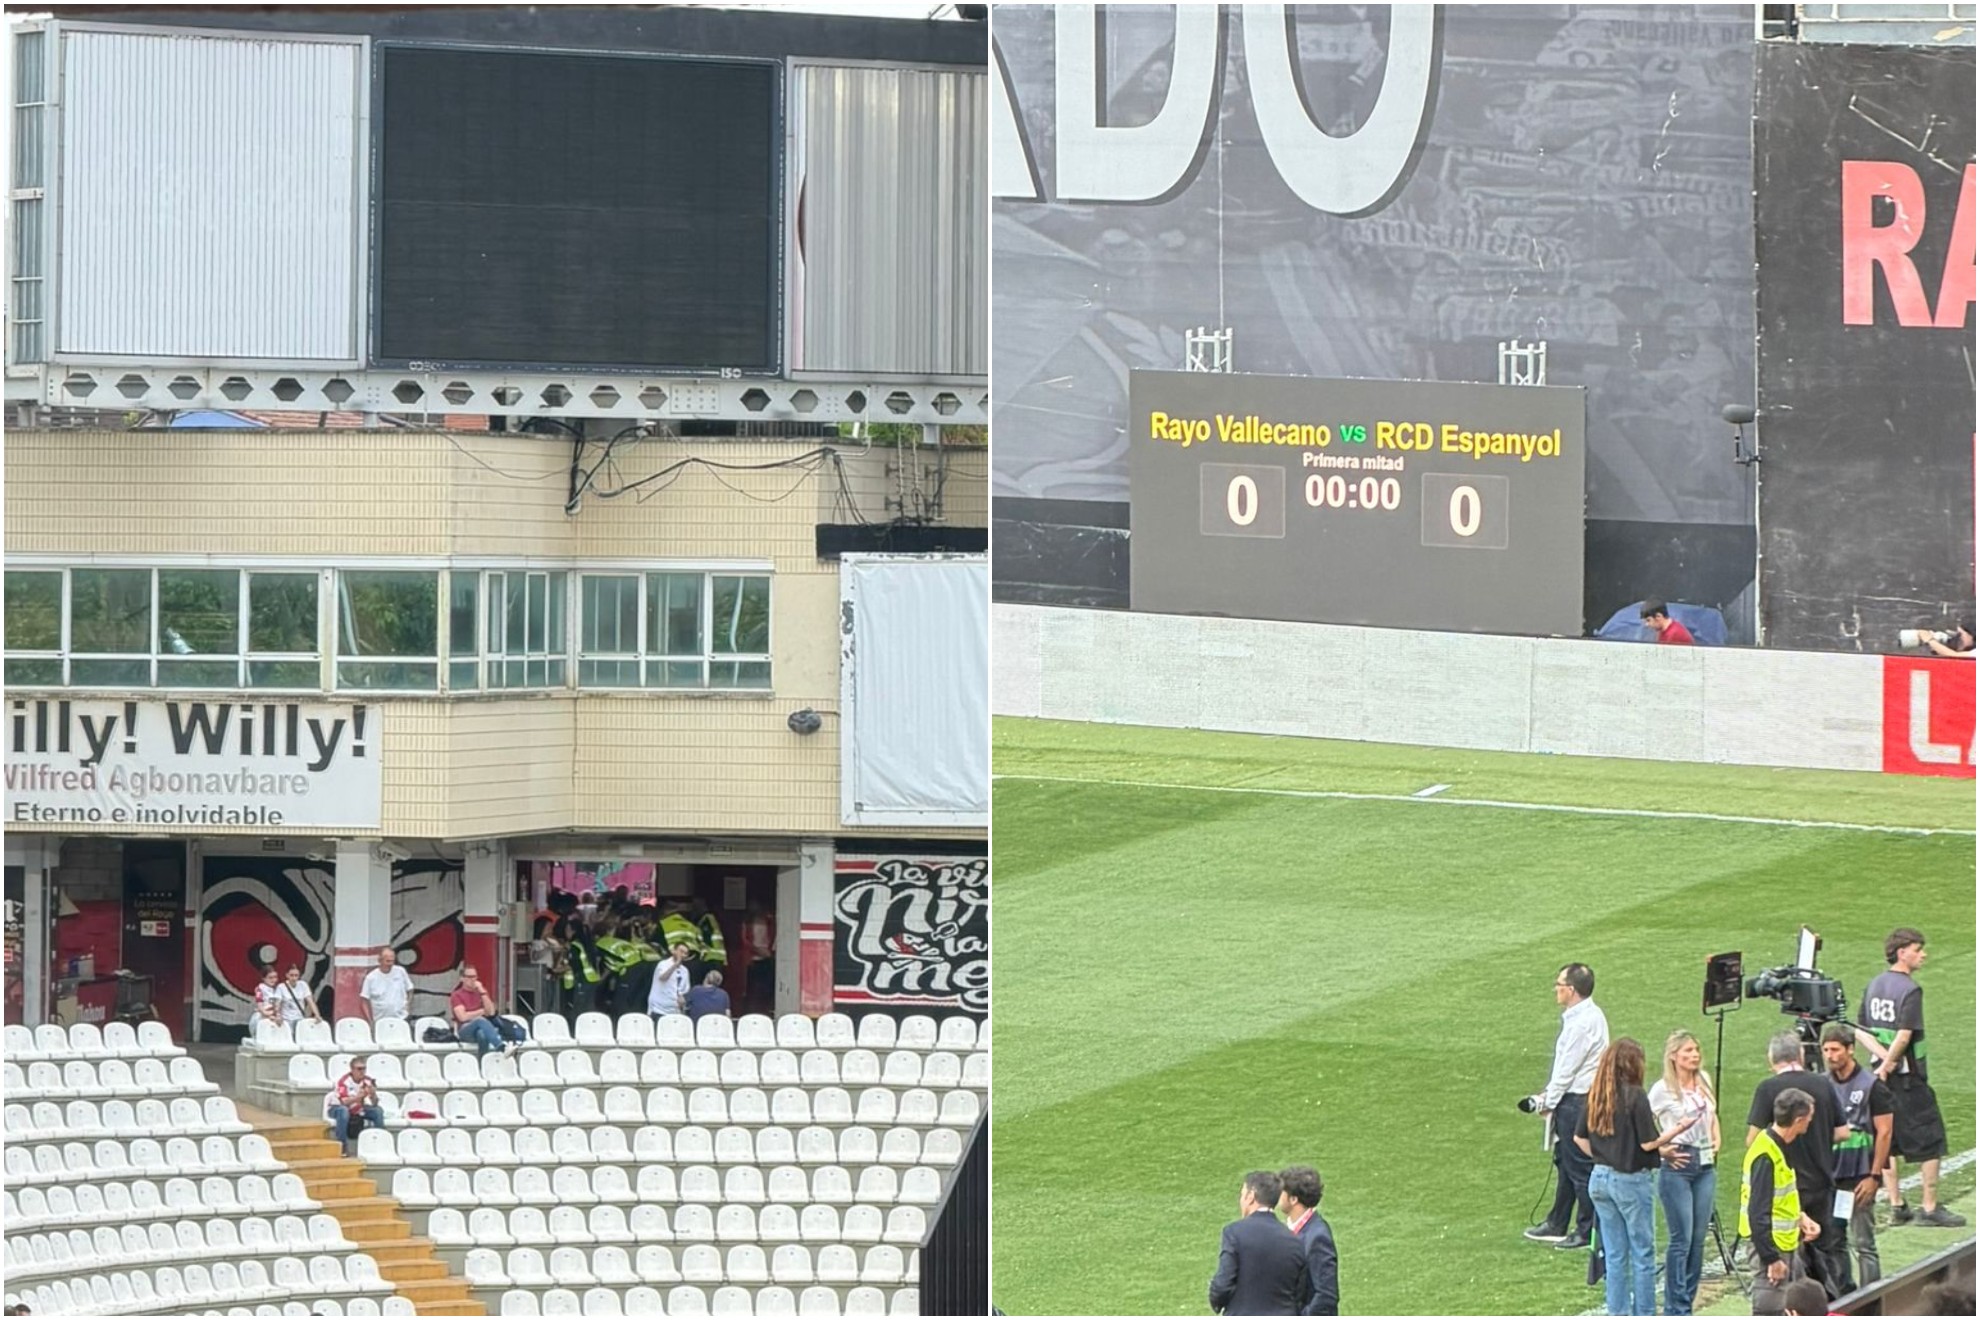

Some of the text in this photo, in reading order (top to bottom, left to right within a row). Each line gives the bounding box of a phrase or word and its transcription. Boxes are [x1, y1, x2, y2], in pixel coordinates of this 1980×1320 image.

[992, 4, 1434, 214] DO
[1151, 411, 1561, 462] Rayo Vallecano vs RCD Espanyol
[1302, 452, 1404, 472] Primera mitad
[1226, 474, 1481, 537] 0 00:00 0
[166, 702, 368, 773] Willy!
[1909, 669, 1977, 765] L
[109, 764, 310, 800] Agbonavbare
[14, 802, 283, 826] Eterno e inolvidable
[937, 862, 988, 888] vi
